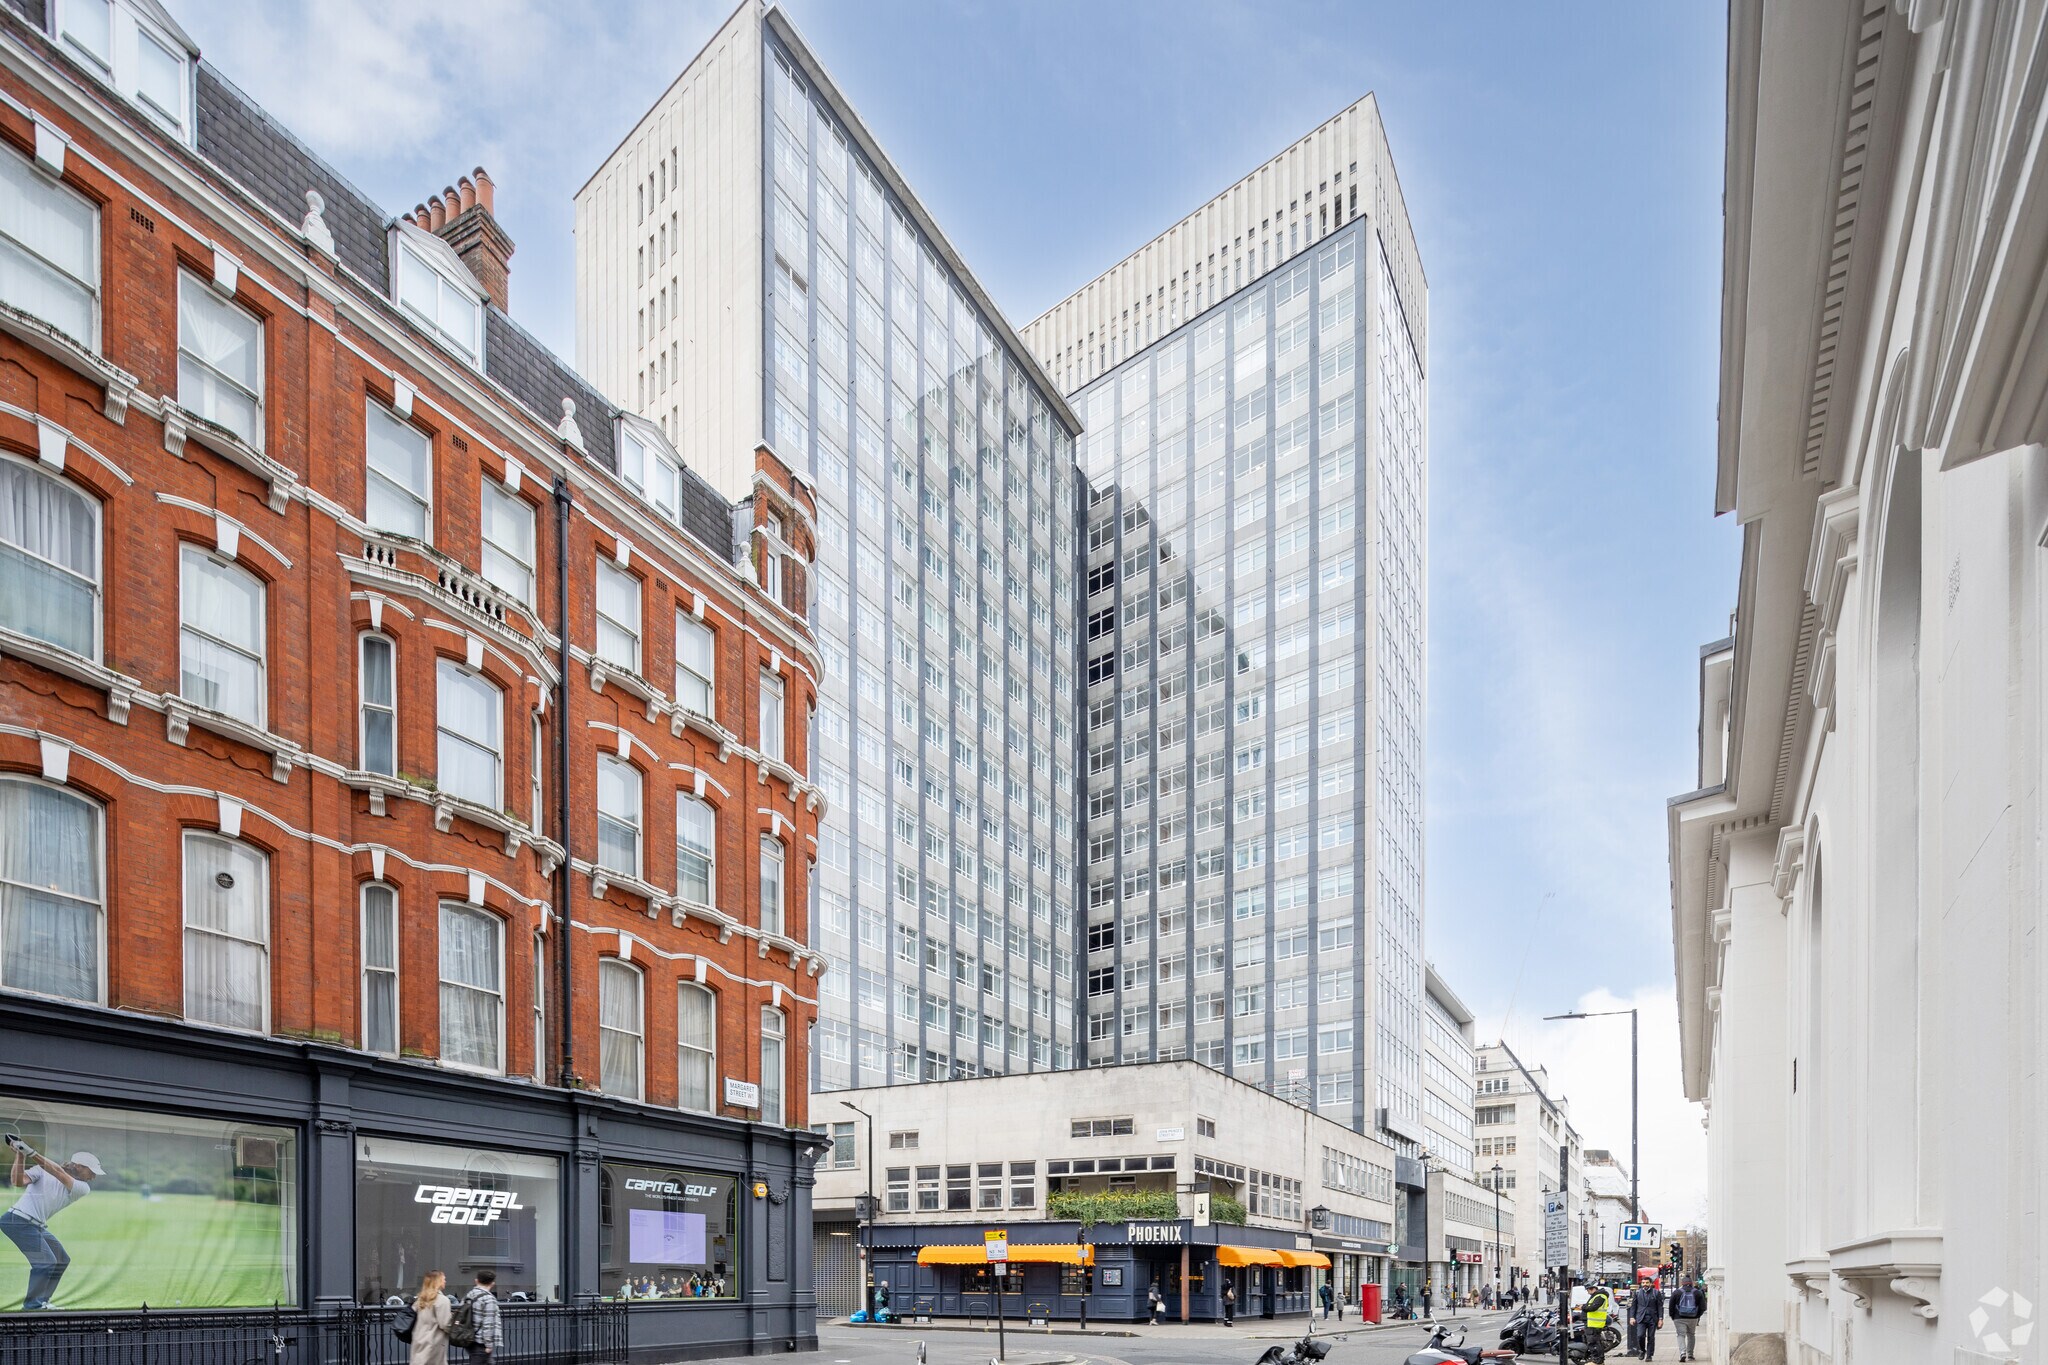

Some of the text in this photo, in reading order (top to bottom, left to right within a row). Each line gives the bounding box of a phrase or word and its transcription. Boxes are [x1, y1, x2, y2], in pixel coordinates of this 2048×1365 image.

[729, 1082, 755, 1093] MARGARET
[729, 1089, 747, 1098] STREET
[625, 1178, 717, 1197] CAPITAL GOLF
[414, 1184, 524, 1226] CAPITAL GOLF
[1128, 1226, 1182, 1242] PHOENIX
